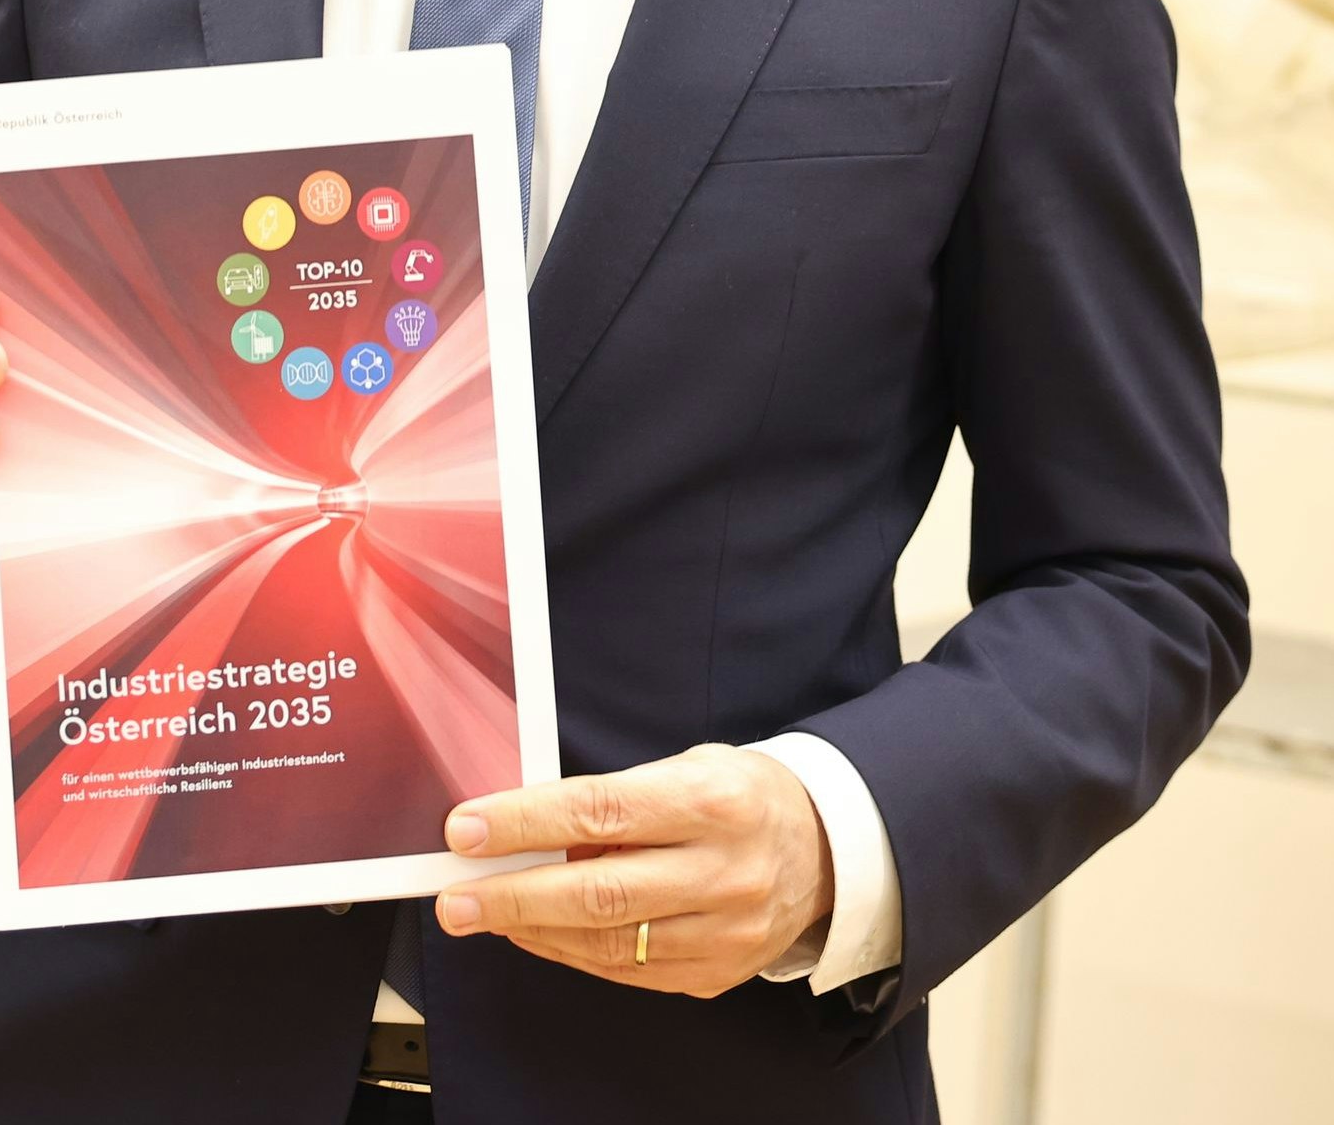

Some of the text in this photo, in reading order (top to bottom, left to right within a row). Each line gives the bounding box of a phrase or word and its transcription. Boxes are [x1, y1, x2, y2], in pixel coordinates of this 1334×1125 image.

[296, 259, 363, 281] TOP-10
[308, 290, 358, 311] 2035
[58, 651, 357, 702] Industriestrategie
[59, 695, 332, 745] Österreich 2035
[61, 750, 345, 786] für einen wettbewerbsfähigen Industriestandort
[63, 777, 233, 802] und wirtschaftliche Resilienz
